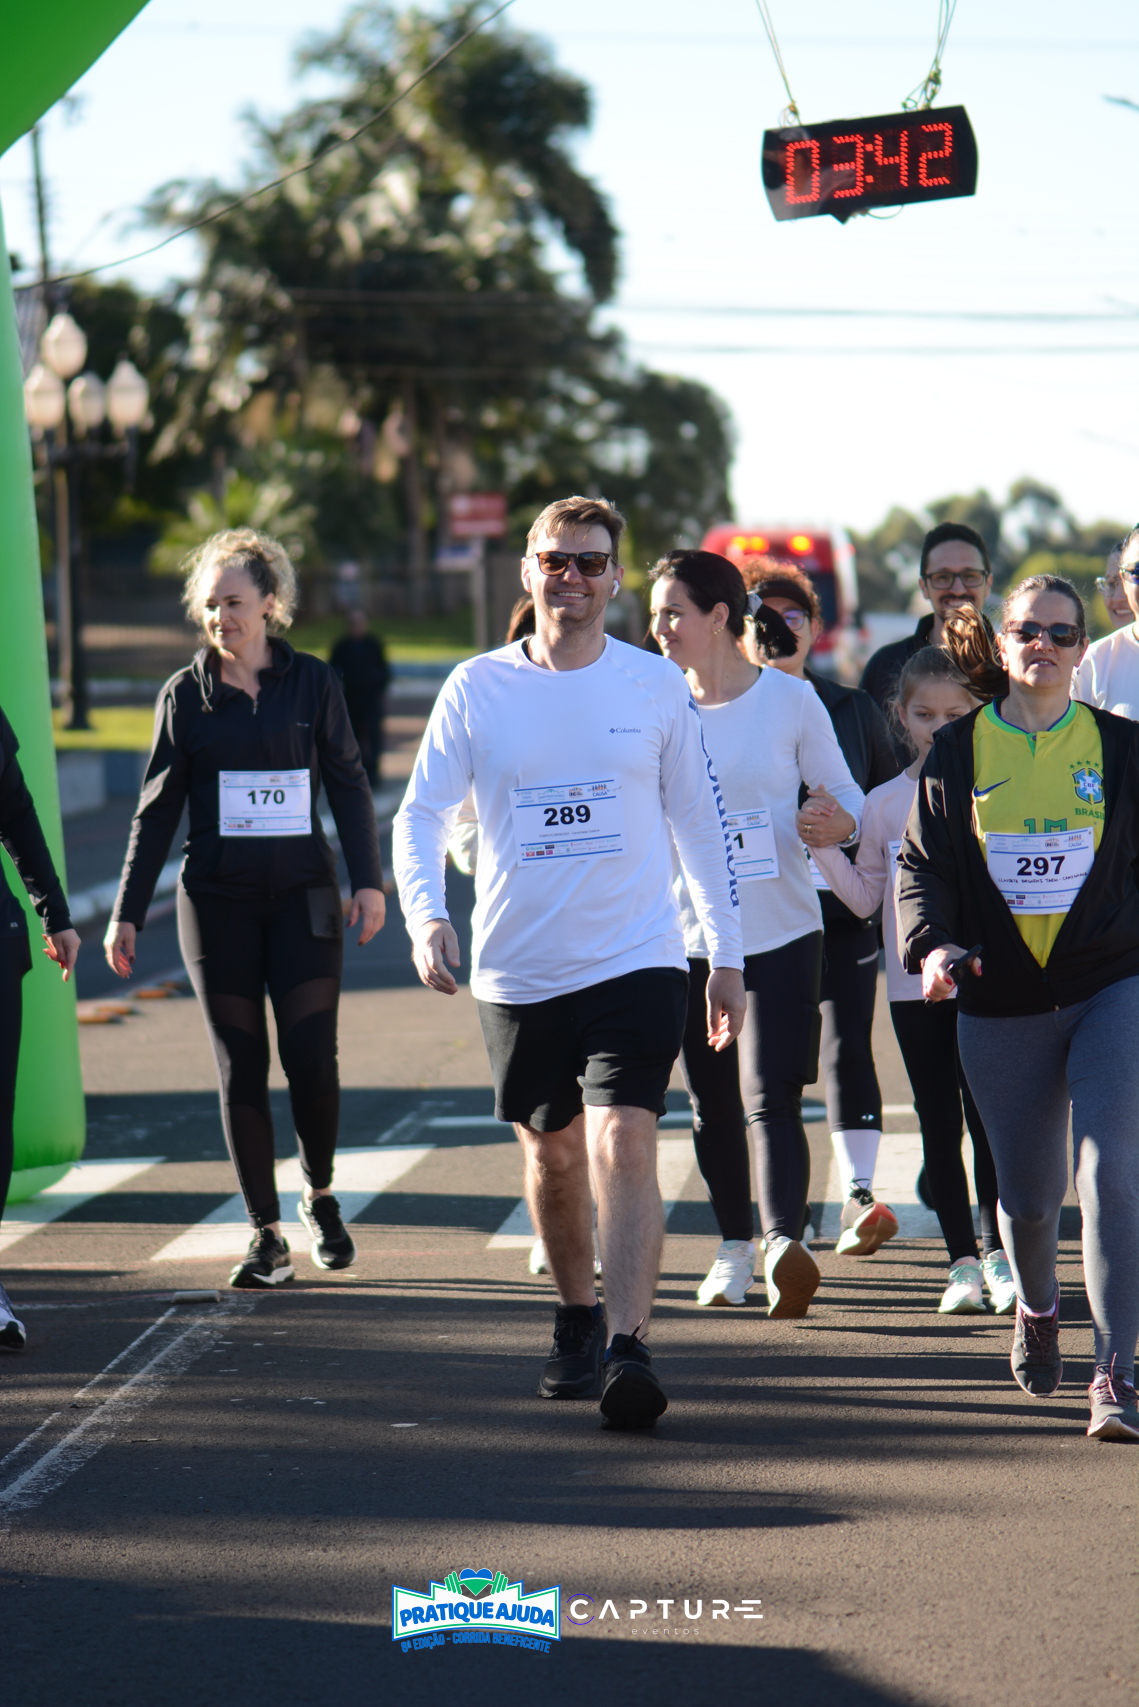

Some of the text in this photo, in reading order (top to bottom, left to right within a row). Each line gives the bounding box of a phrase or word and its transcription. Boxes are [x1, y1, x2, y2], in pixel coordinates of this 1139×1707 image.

[785, 122, 953, 204] 03:42
[247, 789, 285, 805] 170
[543, 804, 591, 826] 289
[1016, 855, 1065, 876] 297
